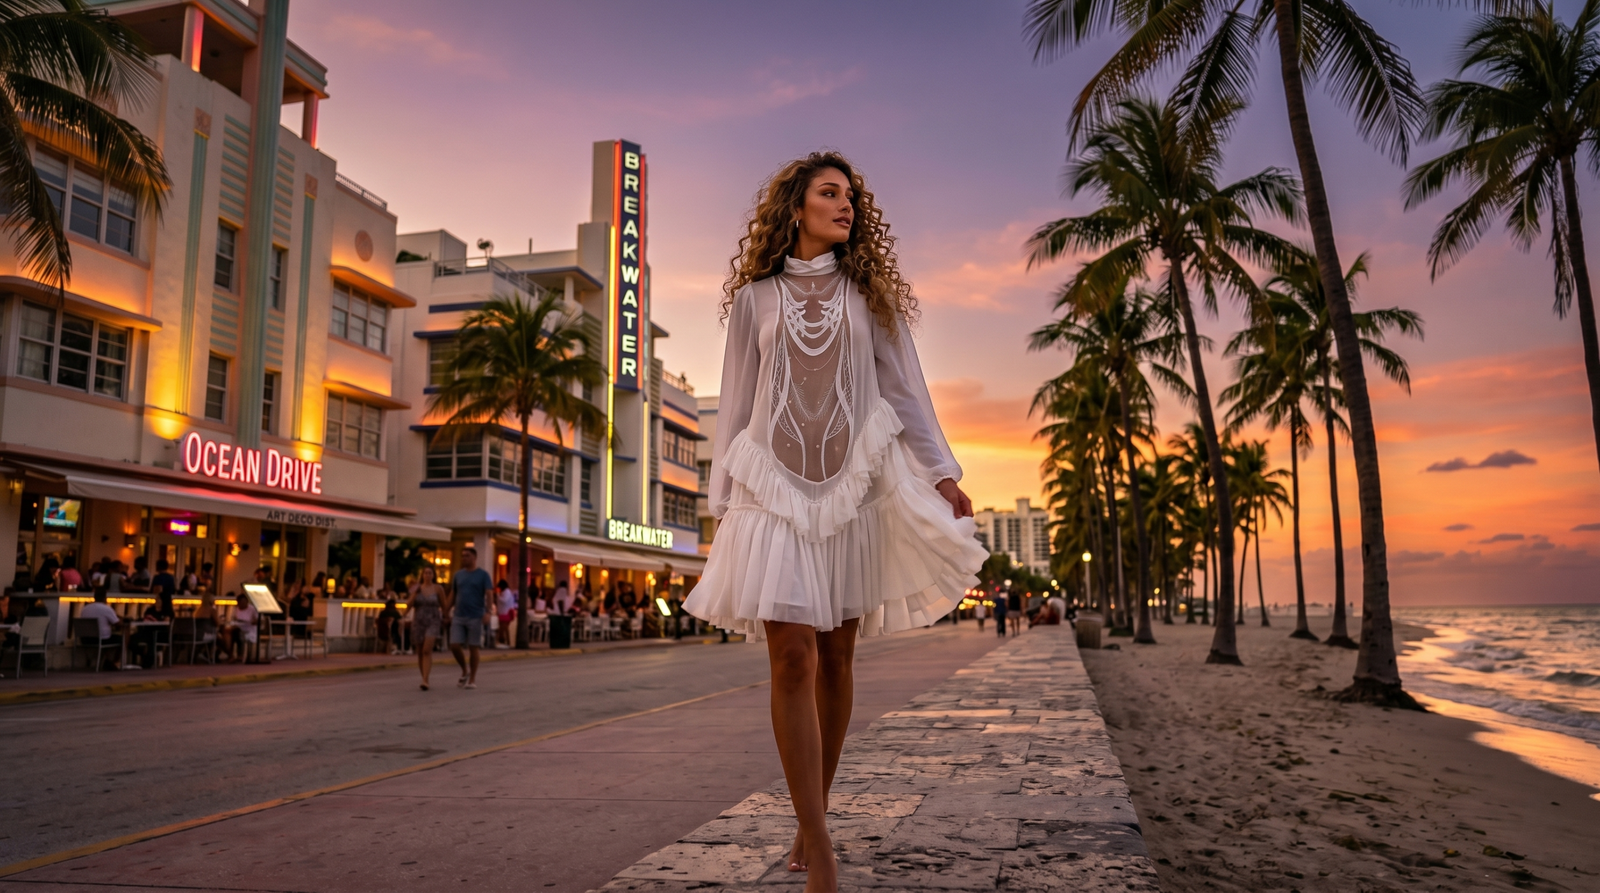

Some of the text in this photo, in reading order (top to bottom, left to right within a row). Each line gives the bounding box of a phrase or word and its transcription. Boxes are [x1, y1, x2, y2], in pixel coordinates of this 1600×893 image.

[621, 151, 640, 377] BREAKWATER
[186, 432, 322, 494] OCEAN DRIVE
[267, 510, 286, 521] ART
[288, 513, 313, 525] DECO
[608, 519, 673, 549] BREAKWATER
